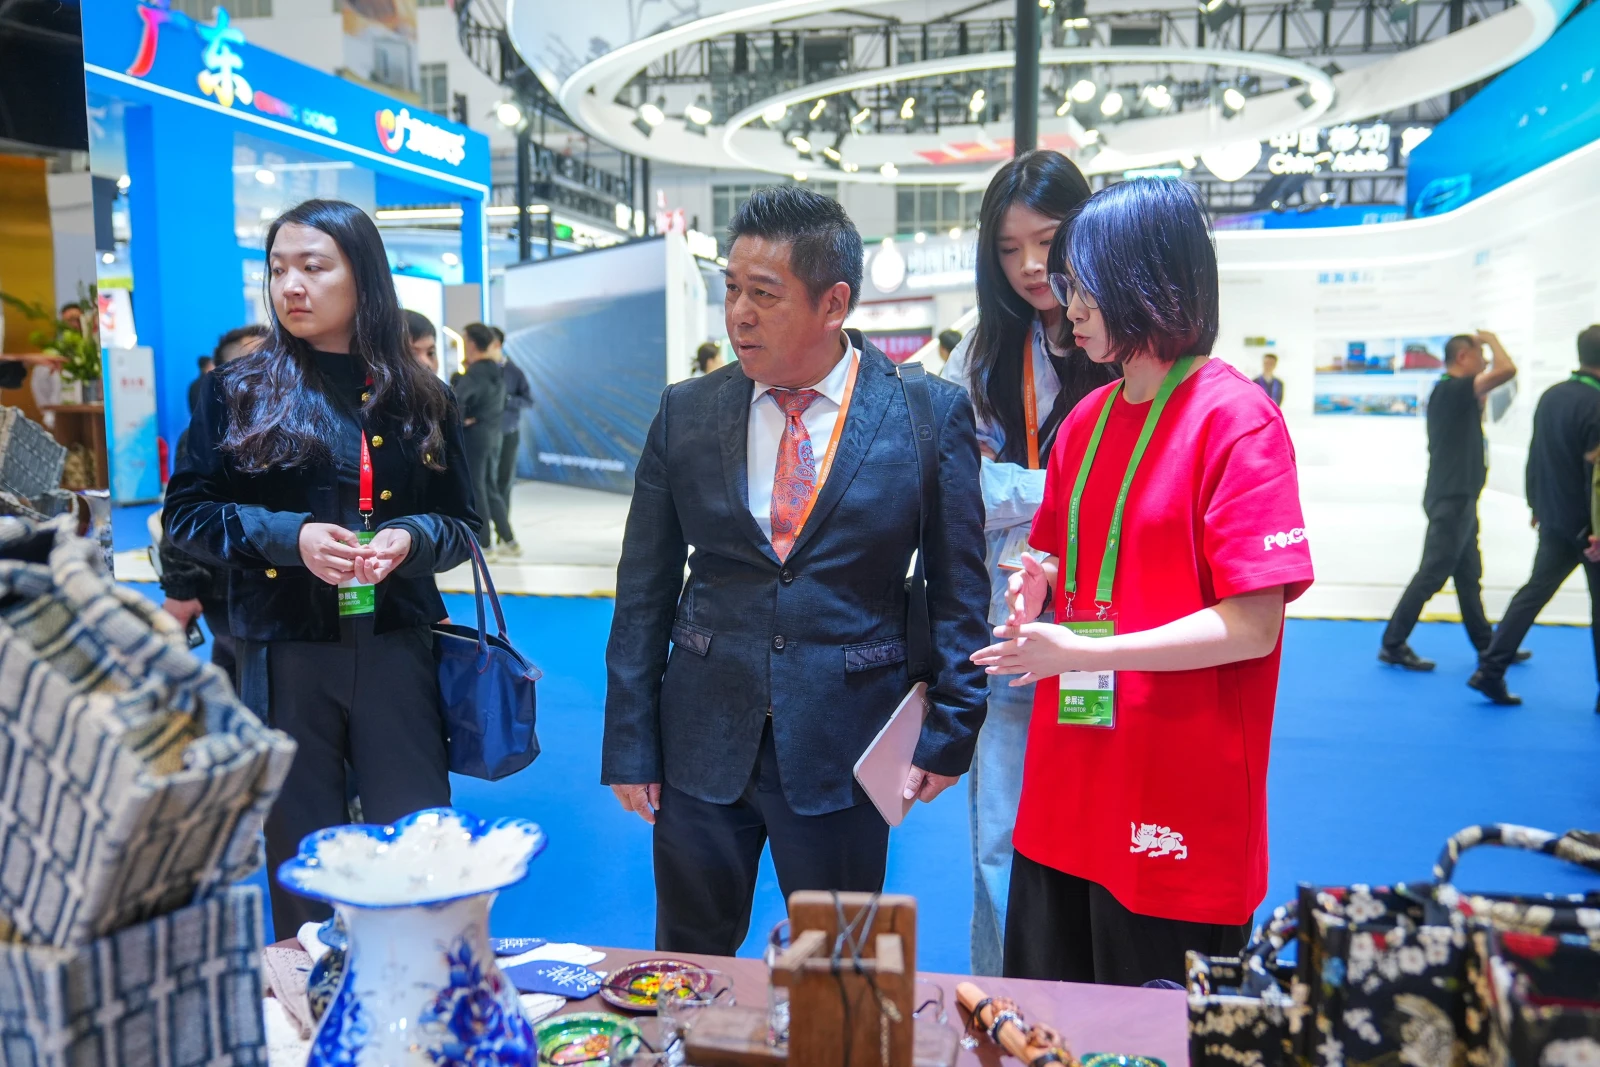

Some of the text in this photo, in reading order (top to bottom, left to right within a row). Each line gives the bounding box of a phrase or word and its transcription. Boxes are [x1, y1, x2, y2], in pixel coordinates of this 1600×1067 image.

[126, 2, 253, 108] 广东
[1064, 695, 1085, 705] 参展证
